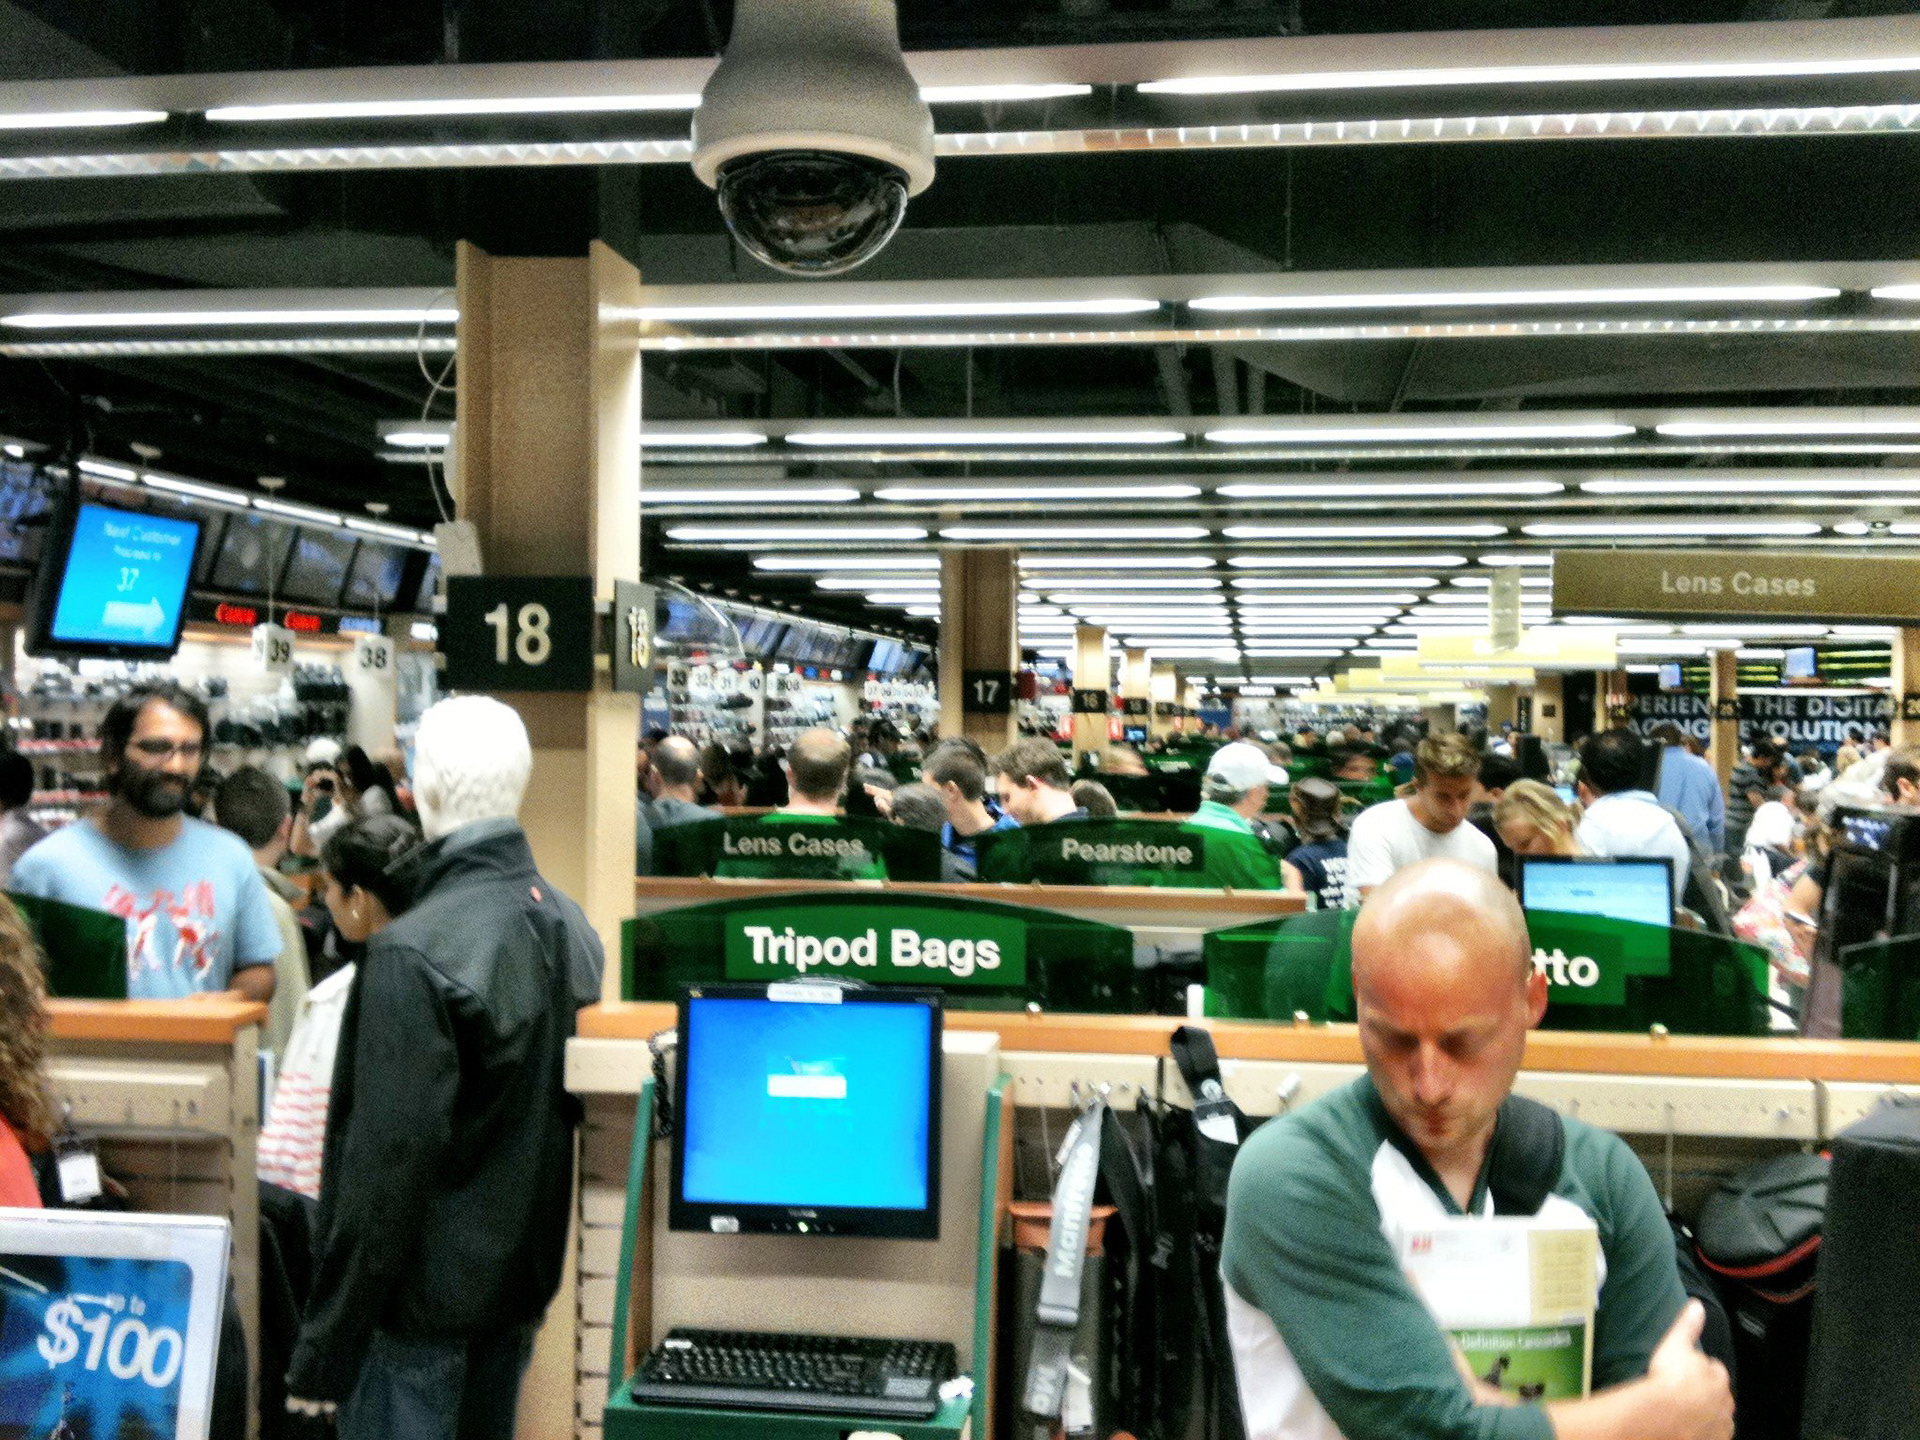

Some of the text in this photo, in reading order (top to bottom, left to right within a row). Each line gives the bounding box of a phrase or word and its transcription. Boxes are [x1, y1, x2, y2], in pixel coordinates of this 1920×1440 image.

[1662, 571, 1816, 597] Lens Cases
[484, 602, 552, 666] 18
[269, 638, 291, 663] 39
[360, 646, 388, 669] 38
[974, 679, 1000, 705] 17
[1753, 697, 1797, 716] THE
[723, 832, 865, 858] Lens Cases
[1061, 838, 1193, 865] Pearstone
[744, 926, 1001, 977] Tripod Bags
[36, 1298, 184, 1388] $100
